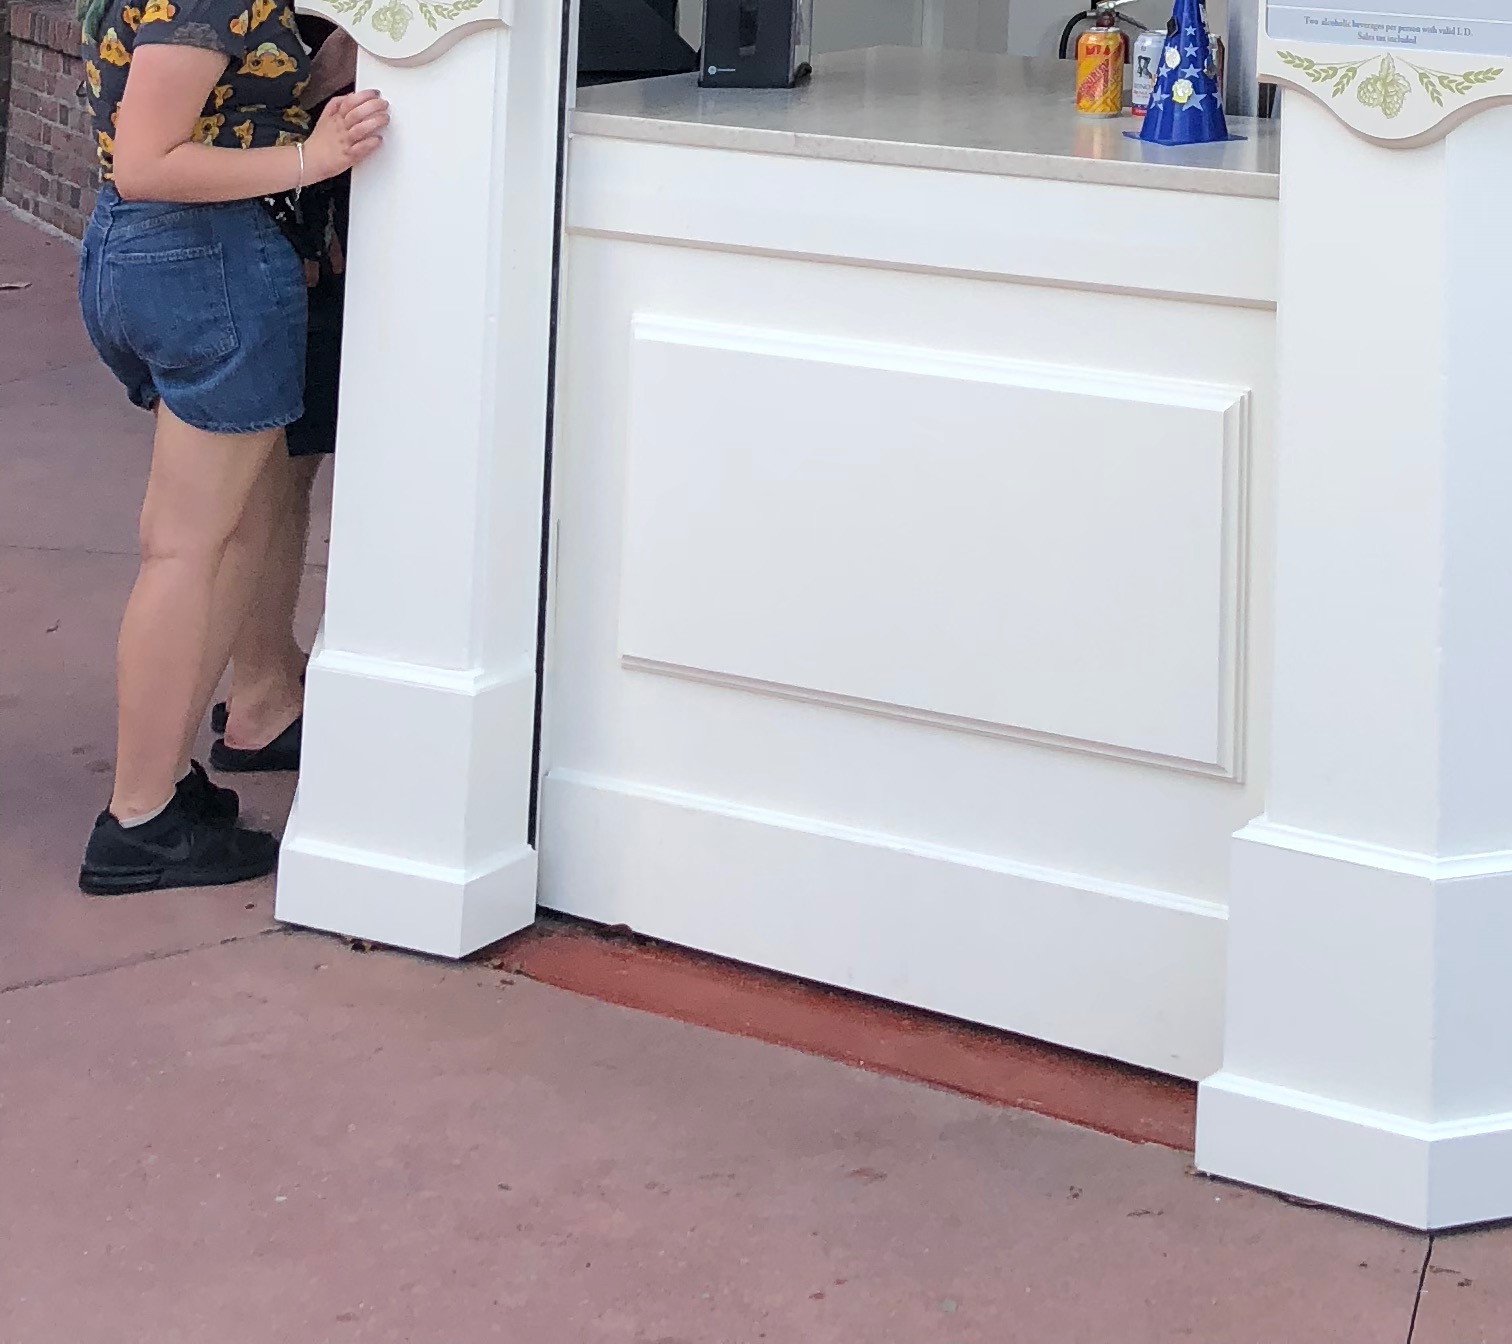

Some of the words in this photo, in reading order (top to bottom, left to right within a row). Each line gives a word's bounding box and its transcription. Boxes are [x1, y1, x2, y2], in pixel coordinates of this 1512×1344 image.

[1304, 16, 1318, 25] Two
[1352, 20, 1384, 31] beverages
[1386, 24, 1396, 34] per
[1398, 24, 1420, 34] person
[1422, 24, 1437, 34] with
[1438, 26, 1456, 36] valid
[1358, 32, 1374, 42] Sales
[1387, 34, 1416, 44] included
